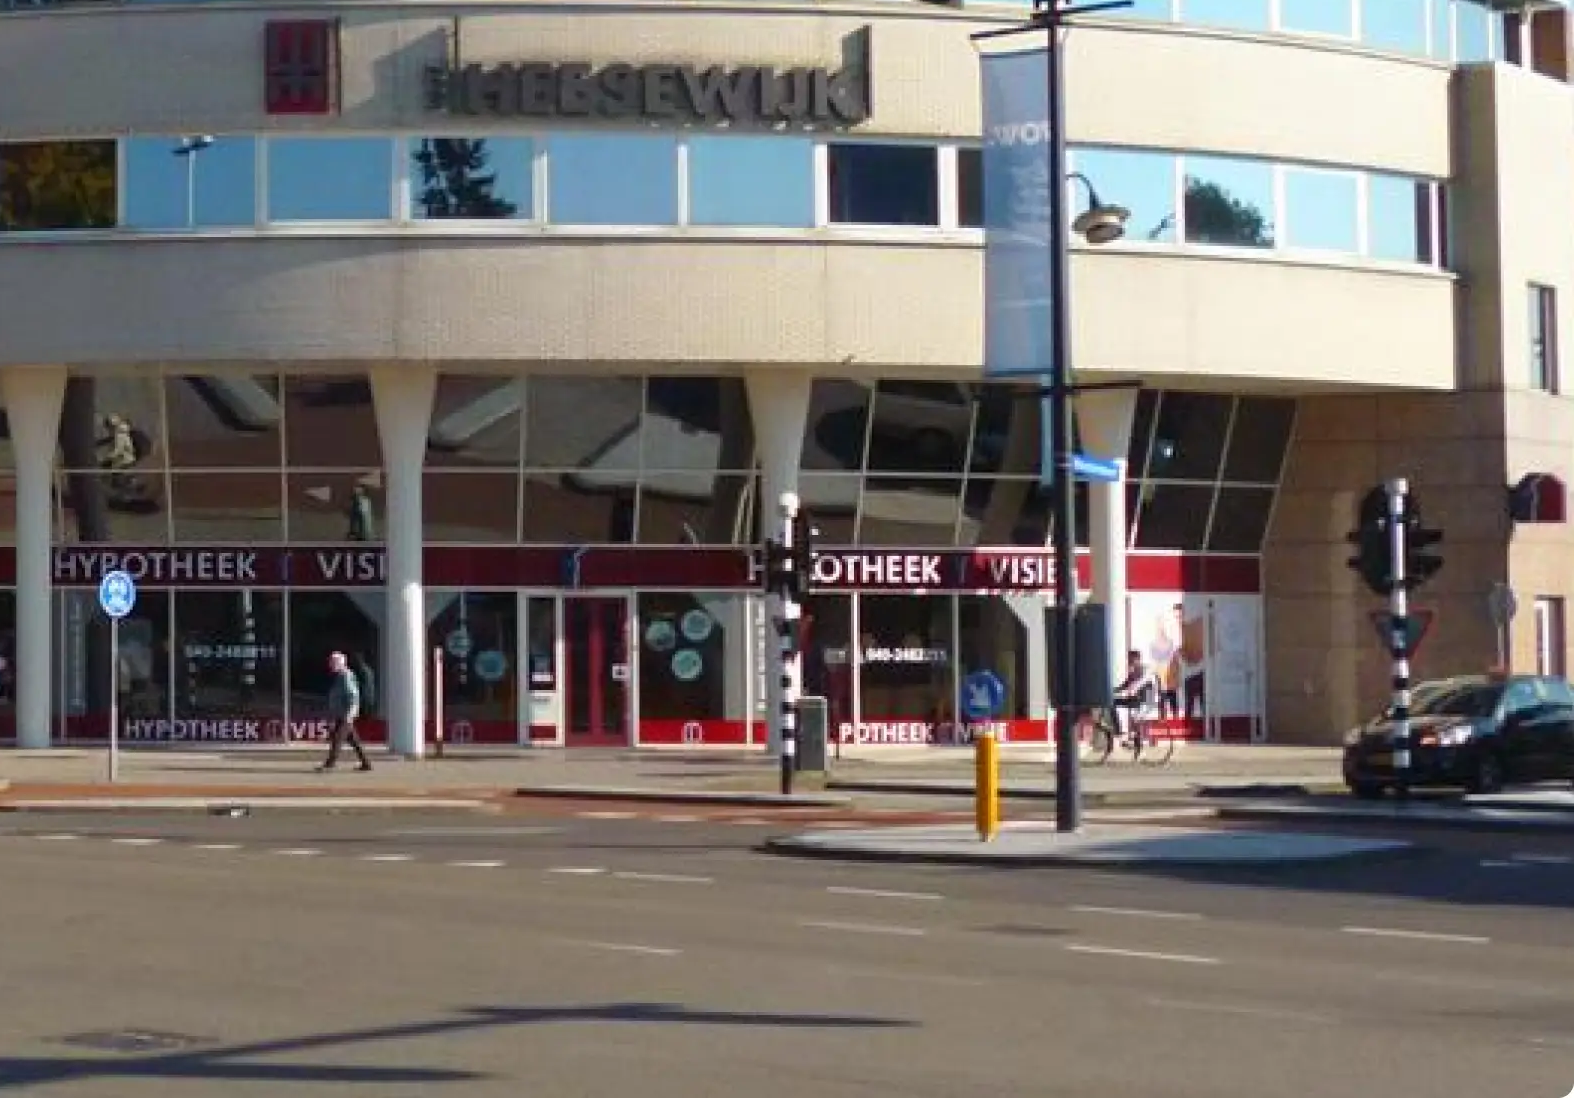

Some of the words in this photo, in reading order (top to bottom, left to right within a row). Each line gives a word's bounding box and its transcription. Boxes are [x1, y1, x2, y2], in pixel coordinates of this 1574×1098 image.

[55, 552, 257, 580] HYPOTHEEK
[317, 552, 384, 580] VISI
[127, 720, 259, 740] HYPOTHEEK
[290, 721, 335, 740] VIS
[838, 722, 934, 743] POTHEEK
